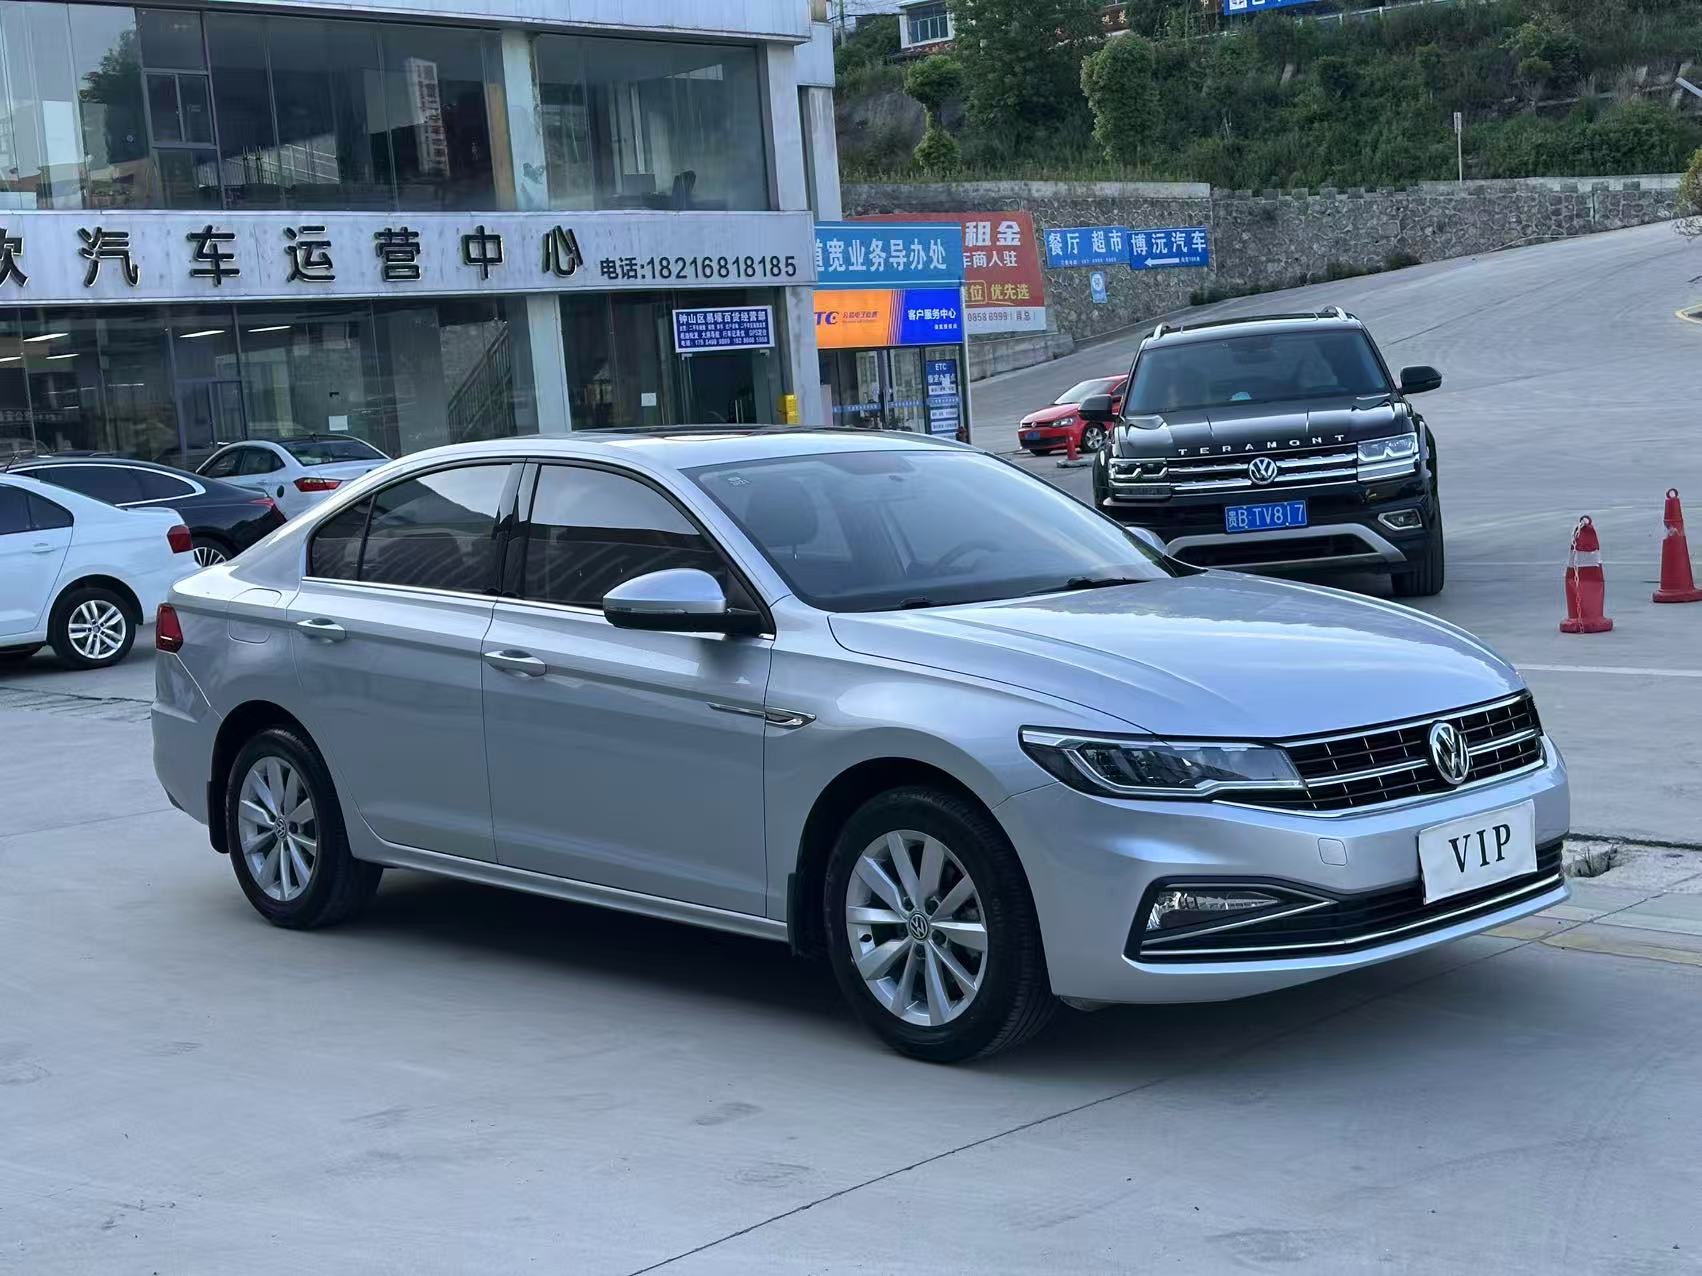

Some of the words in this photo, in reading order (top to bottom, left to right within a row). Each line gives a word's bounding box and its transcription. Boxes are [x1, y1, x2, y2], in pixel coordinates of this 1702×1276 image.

[965, 221, 1021, 247] 租金
[1049, 232, 1079, 256] 餐厅
[1091, 229, 1122, 253] 超市
[1131, 230, 1207, 256] 博沅汽车
[990, 283, 1030, 300] 优先选
[908, 307, 957, 321] 客户服务中心
[935, 363, 947, 371] ETC
[1178, 434, 1346, 456] TERAMONT
[1448, 823, 1512, 874] VIP
